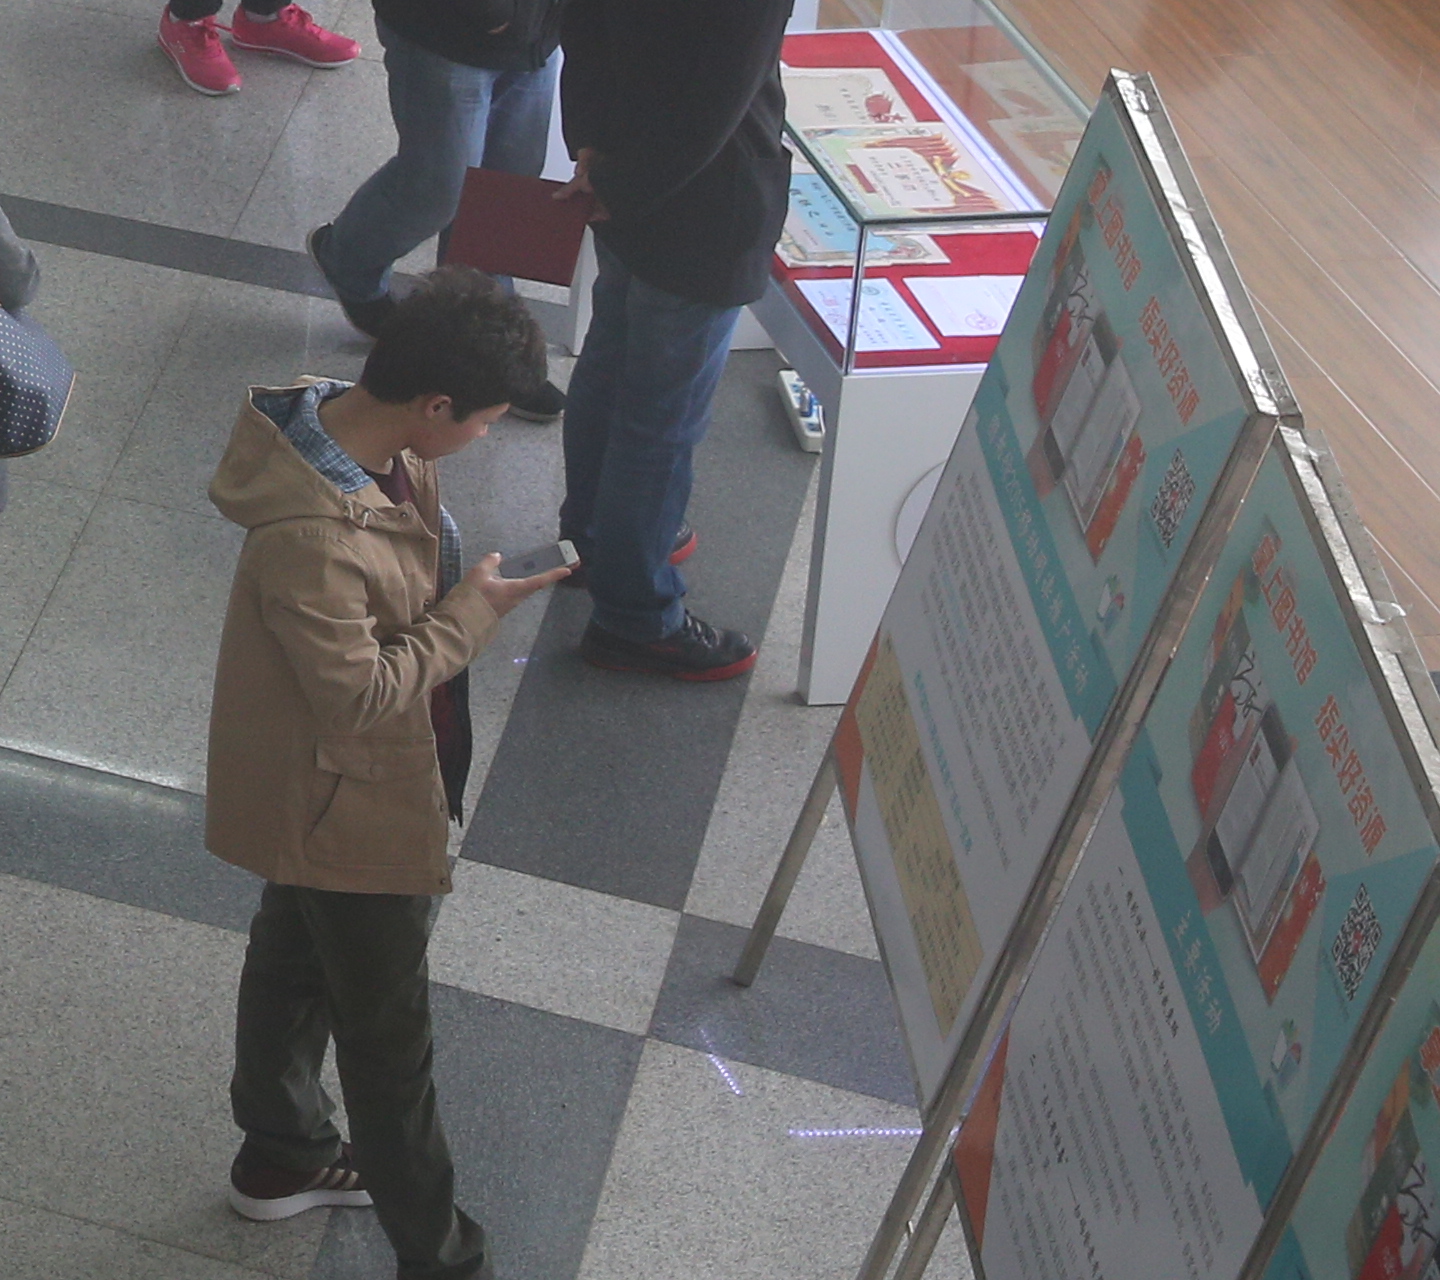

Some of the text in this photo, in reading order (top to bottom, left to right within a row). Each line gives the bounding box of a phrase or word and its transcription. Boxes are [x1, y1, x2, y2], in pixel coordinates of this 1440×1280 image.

[1088, 167, 1201, 427] 掌上图书馆 指尖好资源
[1251, 534, 1387, 858] 掌上图书馆 指尖好资源
